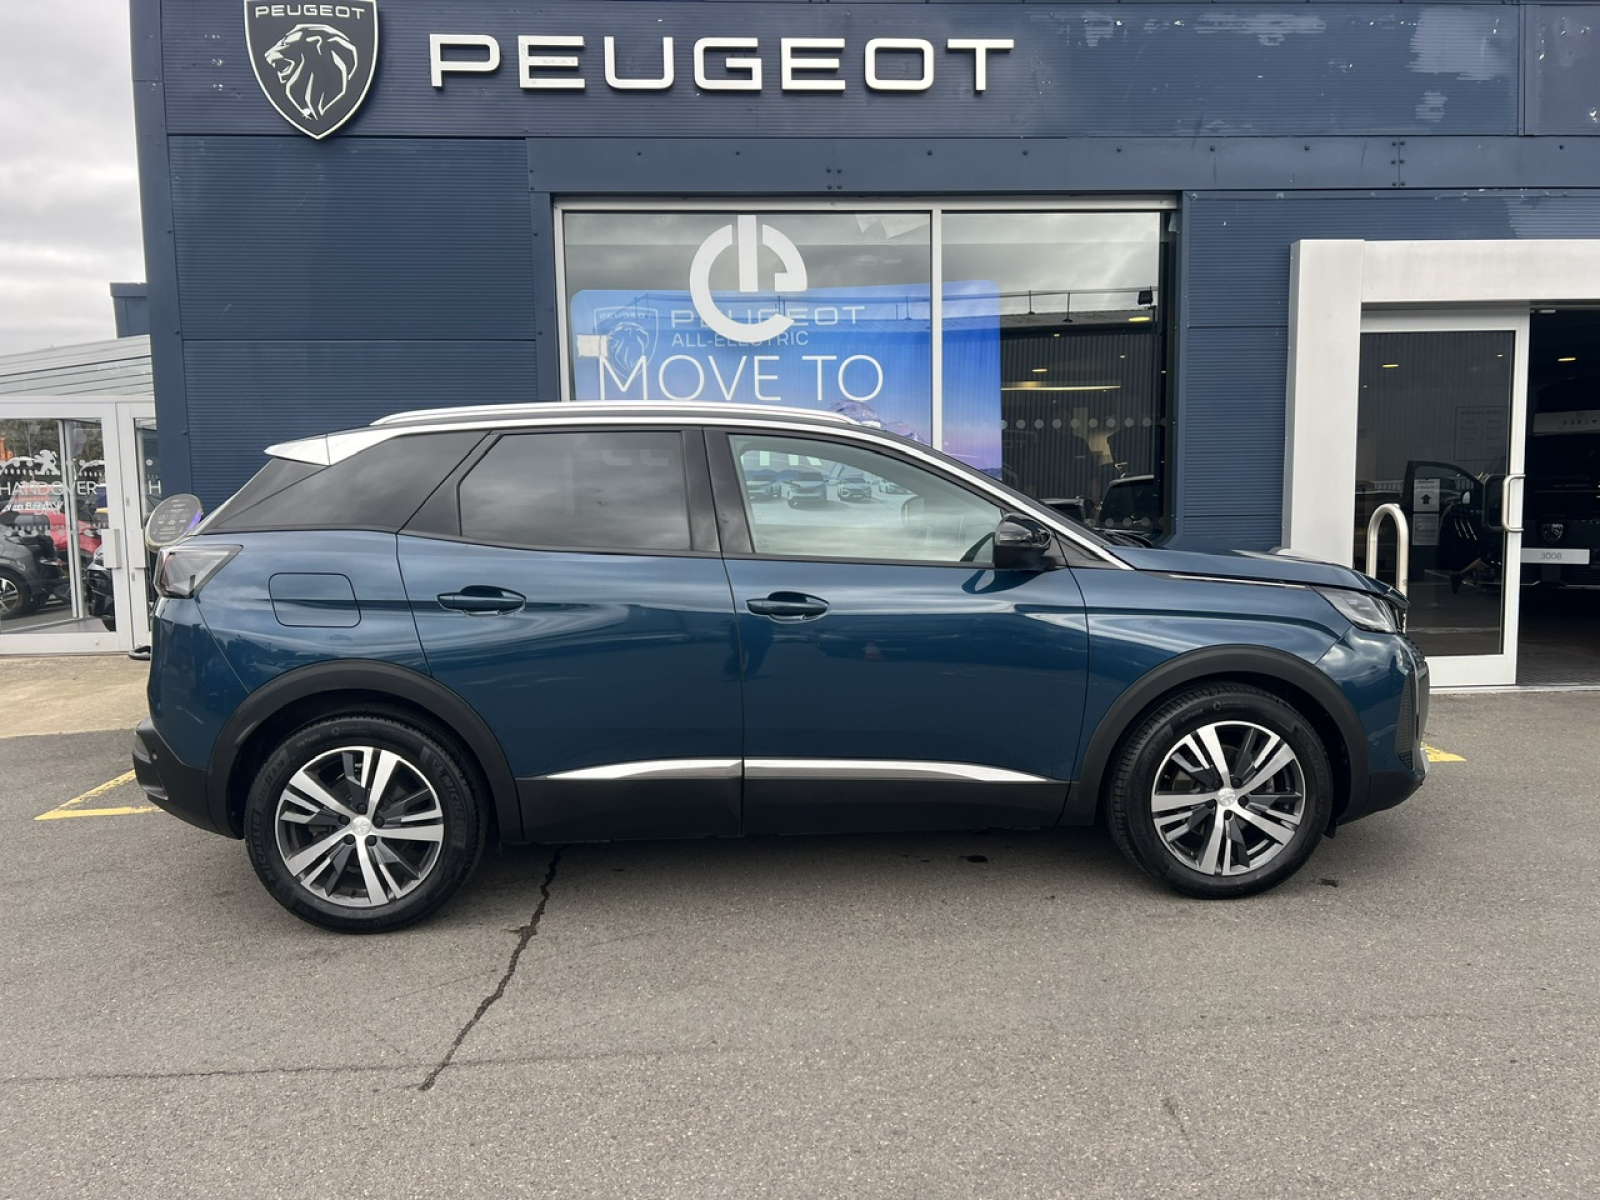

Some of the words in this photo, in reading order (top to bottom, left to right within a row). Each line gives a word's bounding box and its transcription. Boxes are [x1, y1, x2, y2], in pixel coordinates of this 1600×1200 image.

[255, 4, 366, 20] PEUGEOT
[429, 34, 1014, 91] PEUGEOT
[671, 305, 866, 329] PEOT
[671, 331, 809, 348] ALL-ELRIC
[599, 354, 782, 402] MOVE
[801, 354, 884, 402] TO
[0, 480, 97, 496] HANDOVER
